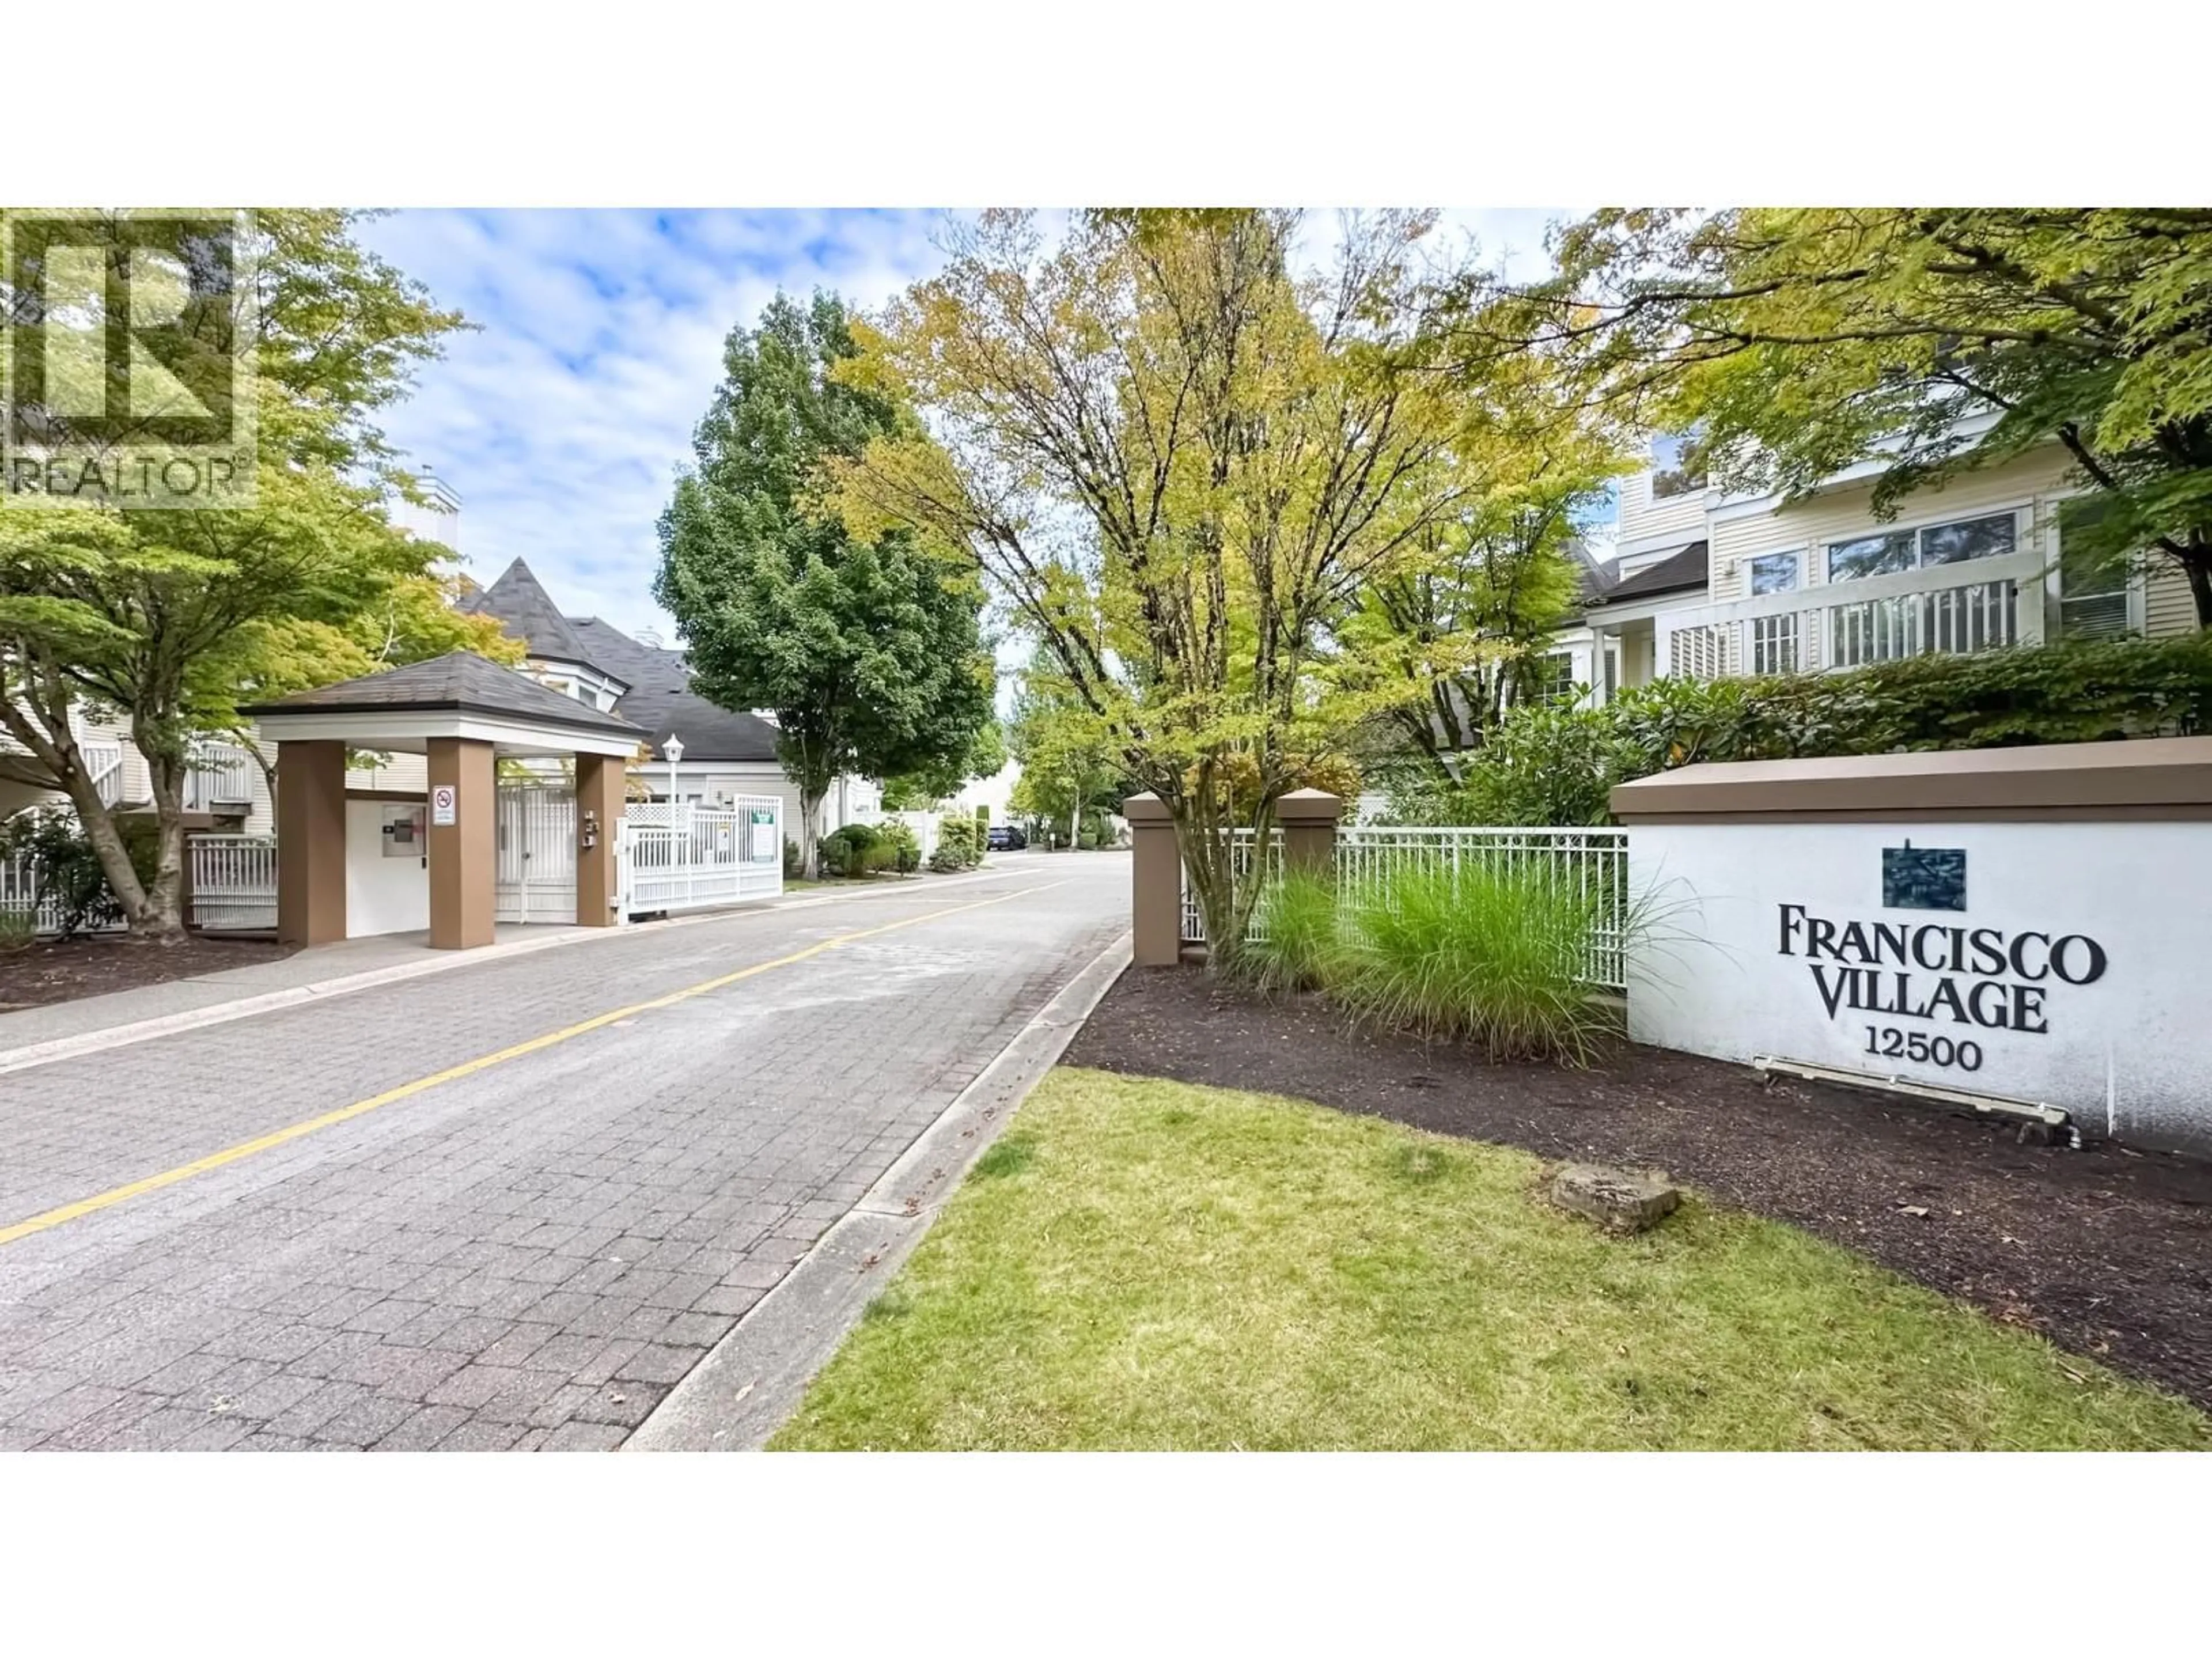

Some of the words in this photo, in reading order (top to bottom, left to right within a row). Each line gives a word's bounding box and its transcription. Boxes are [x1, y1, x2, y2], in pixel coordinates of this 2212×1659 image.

[1778, 903, 2107, 985] FRANCISCO
[1809, 964, 2048, 1034] VILLAGE
[1865, 1025, 1983, 1071] 12500
